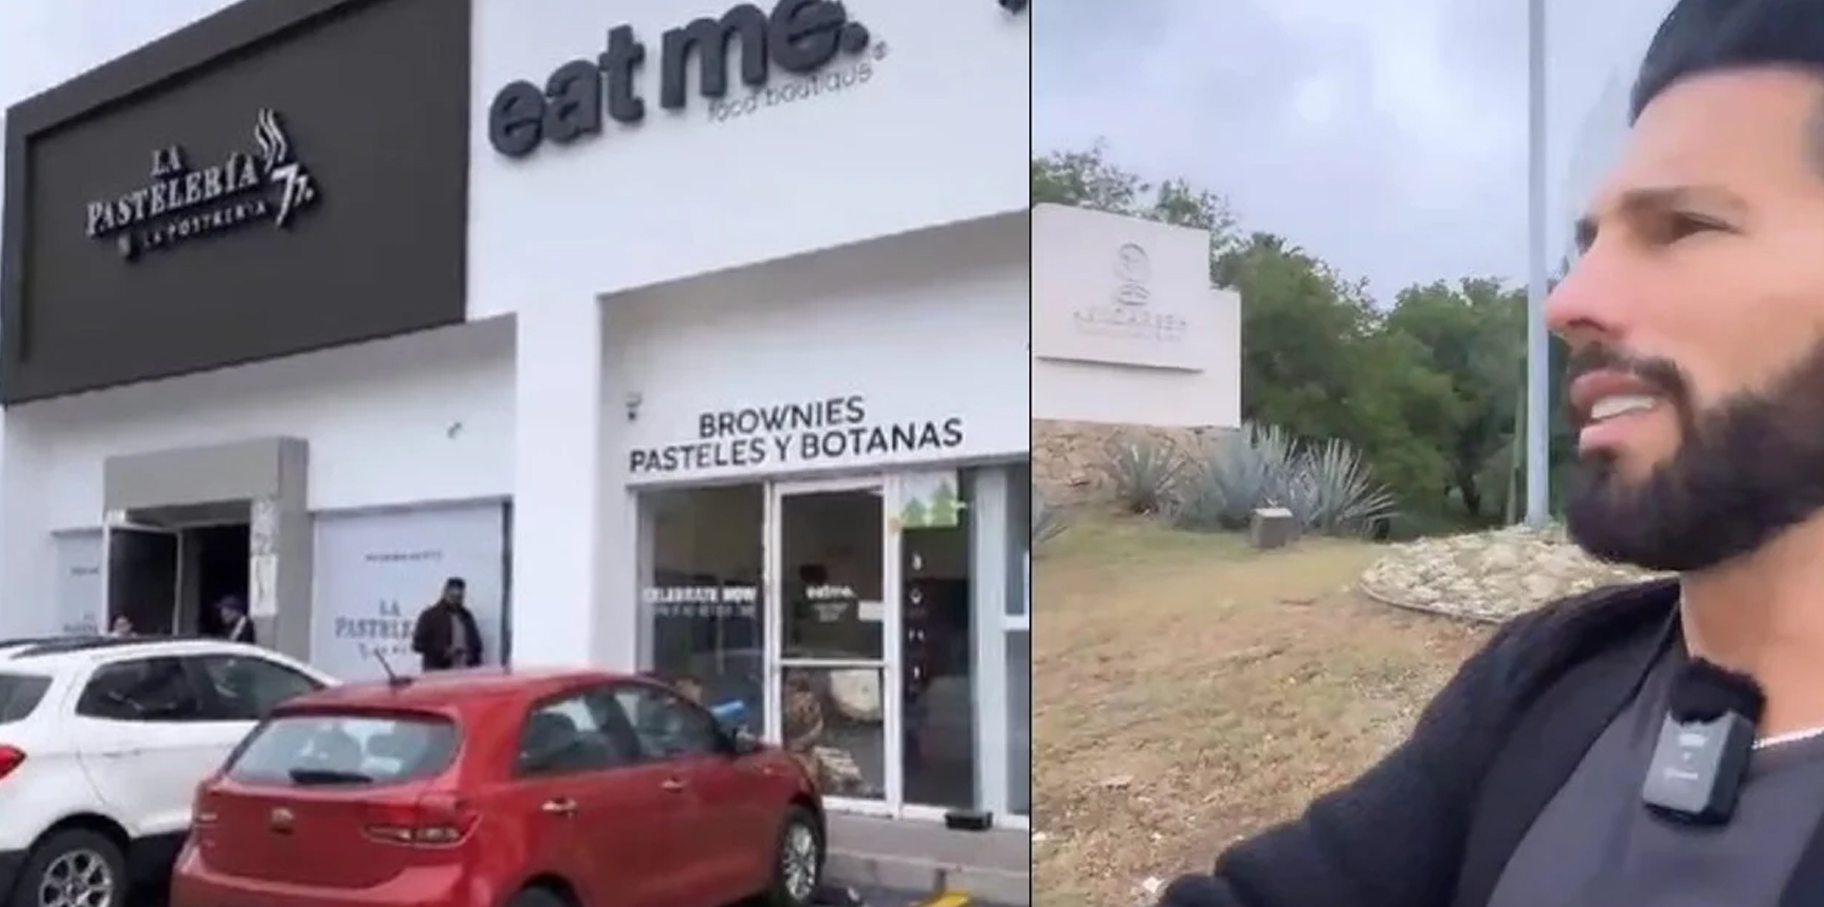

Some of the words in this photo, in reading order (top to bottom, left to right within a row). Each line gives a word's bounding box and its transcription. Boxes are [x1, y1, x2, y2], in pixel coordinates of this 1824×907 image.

[488, 25, 645, 158] eat
[708, 94, 758, 122] food
[151, 145, 182, 176] LA
[699, 395, 866, 440] BROWNIES
[629, 438, 766, 473] PASTELES
[773, 435, 793, 461] Y
[801, 417, 964, 460] BOTANAS
[379, 598, 401, 617] LA
[335, 616, 414, 639] PASTELE
